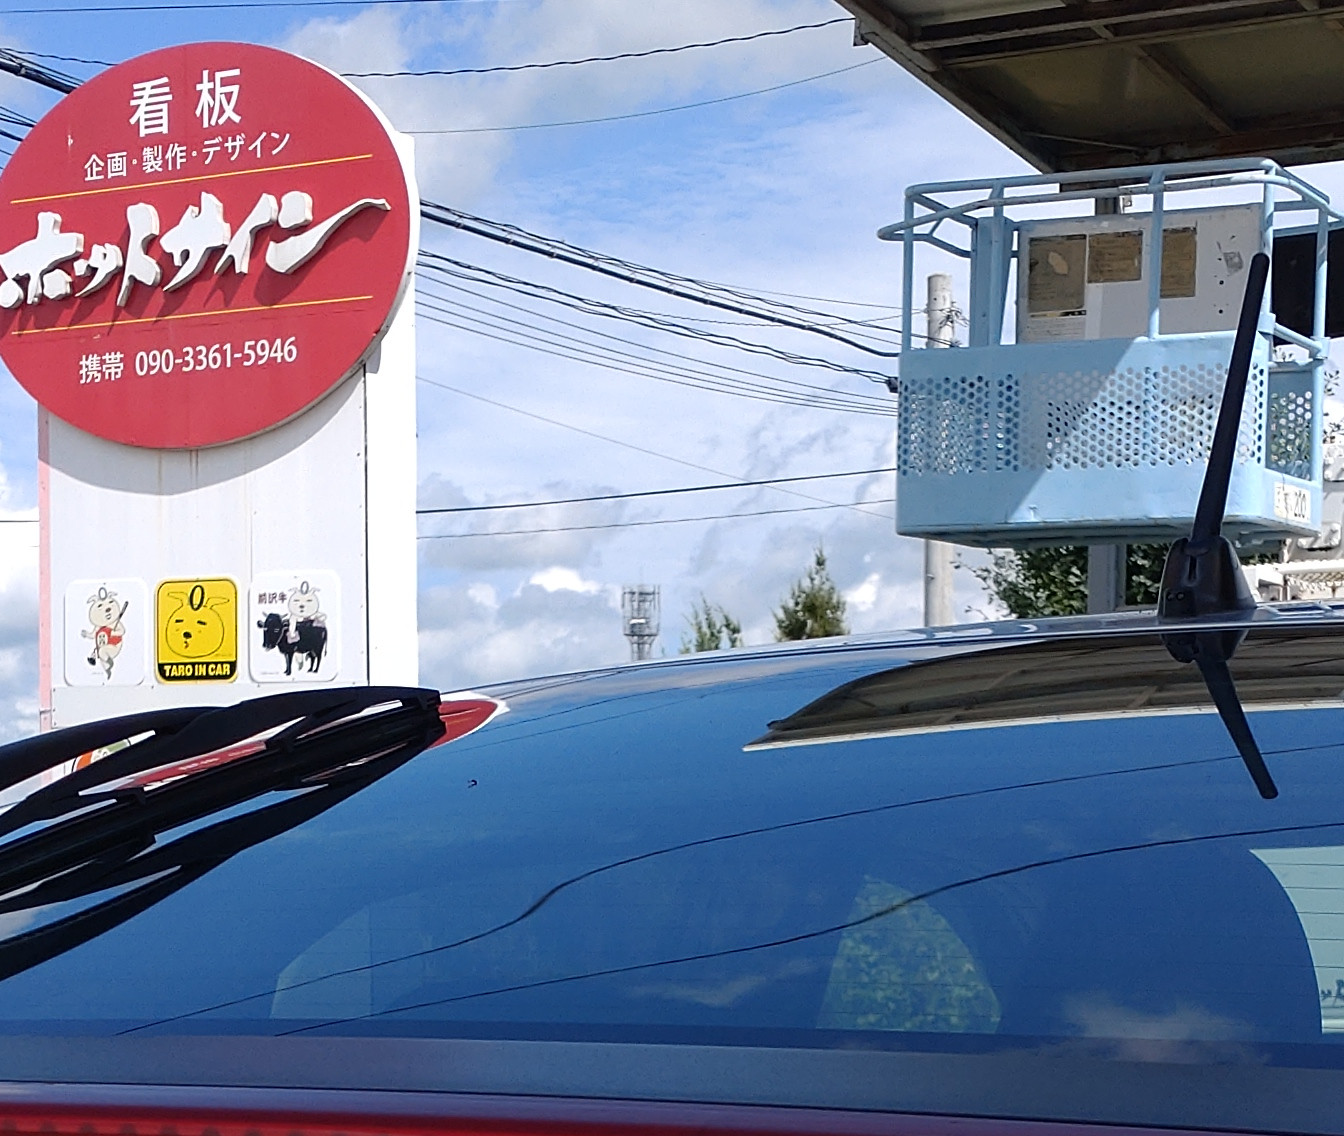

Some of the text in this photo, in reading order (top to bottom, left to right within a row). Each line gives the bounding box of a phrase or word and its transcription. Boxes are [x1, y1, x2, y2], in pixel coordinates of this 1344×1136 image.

[129, 68, 242, 138] 看板
[78, 336, 298, 384] 携帯 090-3361-5946
[163, 663, 231, 677] TARO IN CAR
